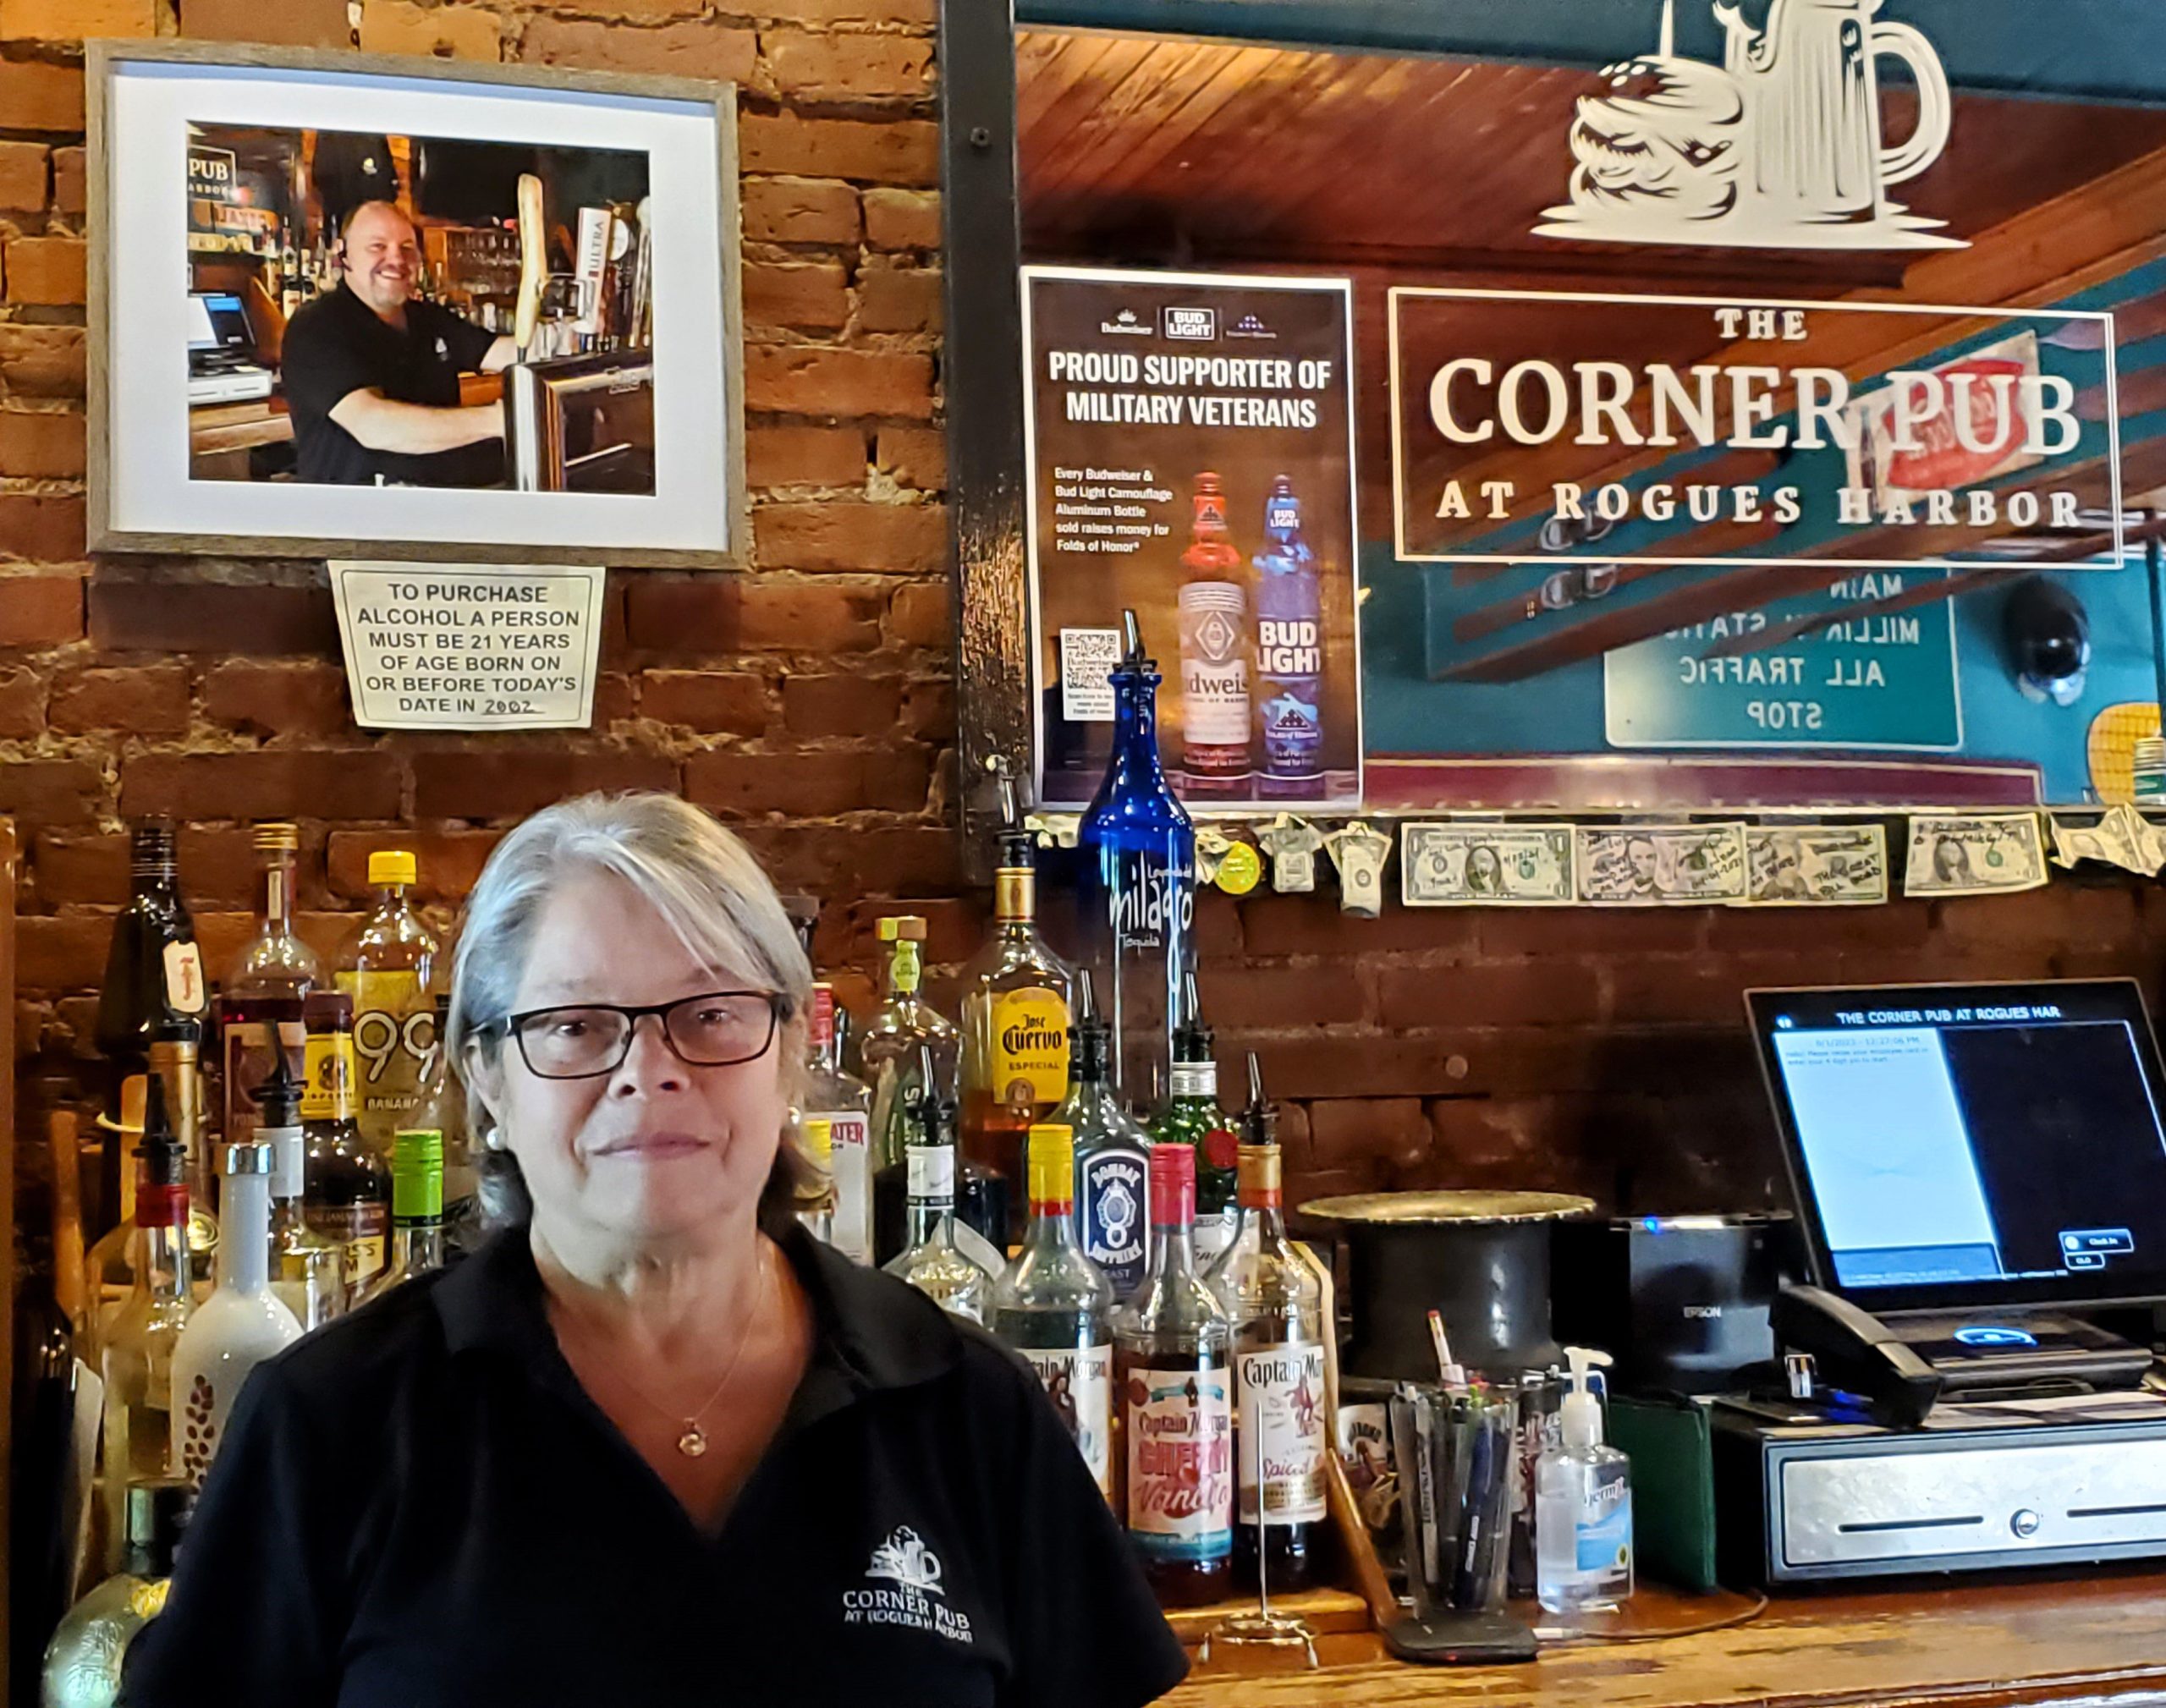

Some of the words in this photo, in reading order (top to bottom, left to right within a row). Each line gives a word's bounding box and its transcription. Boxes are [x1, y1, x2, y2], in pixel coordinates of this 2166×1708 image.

[189, 158, 228, 180] PUB
[590, 220, 606, 269] ULTRA
[1174, 311, 1206, 323] BUD
[1715, 309, 1808, 339] THE
[1168, 323, 1211, 336] LIGHT
[1048, 351, 1139, 383] PROUD
[1144, 355, 1292, 388] SUPPORTER
[1298, 360, 1332, 389] OF
[1066, 392, 1183, 423] MILITARY
[1188, 396, 1317, 427] VETERANS
[1429, 359, 1853, 448] CORNER
[1885, 371, 2080, 455] PUB
[1054, 467, 1084, 482] Every
[1086, 468, 1141, 481] Budweiser
[1143, 470, 1153, 481] &
[1054, 485, 1077, 497] Bud
[1079, 486, 1106, 500] Light
[1108, 486, 1173, 502] Camouflage
[1055, 503, 1111, 516] Aluminum
[1113, 505, 1146, 517] Bottle
[1436, 481, 1514, 519] AT
[1553, 482, 1801, 522] ROGUES
[1838, 490, 2082, 528] HARBOR
[1273, 509, 1296, 518] BUD
[1055, 521, 1079, 533] sold
[1081, 523, 1113, 534] raises
[1116, 525, 1152, 537] money
[1154, 524, 1170, 535] for
[1270, 519, 1300, 528] LIGHT
[1057, 539, 1086, 551] Folds
[1087, 540, 1099, 552] of
[388, 584, 419, 600] TO
[426, 585, 548, 602] PURCHASE
[357, 608, 465, 626] ALCOHOL
[470, 611, 485, 626] A
[492, 611, 579, 627] PERSON
[369, 633, 428, 648] MUST
[436, 634, 465, 649] BE
[470, 634, 492, 649] 21
[499, 634, 570, 649] YEARS
[1259, 621, 1317, 646] BUD
[381, 656, 409, 670] OF
[415, 656, 459, 670] AGE
[465, 656, 524, 671] BORN
[531, 656, 560, 670] ON
[366, 677, 396, 690] OR
[404, 678, 485, 692] BEFORE
[492, 677, 576, 691] TODAY'S
[399, 698, 451, 712] DATE
[457, 699, 475, 712] IN
[1836, 1013, 1864, 1024] THE
[1868, 1011, 1921, 1024] CORNER
[1926, 1010, 1952, 1022] PUB
[1956, 1009, 1972, 1020] AT
[1976, 1007, 2030, 1019] ROGUES
[2031, 1006, 2061, 1018] HAR
[353, 1009, 435, 1083] 99
[1002, 1024, 1062, 1056] Cuervo
[1009, 1062, 1059, 1071] ESPECIAL
[1684, 1306, 1721, 1318] EPSON
[1244, 1357, 1302, 1388] Captain
[1139, 1412, 1187, 1437] Captain
[843, 1590, 929, 1616] CORNER
[934, 1602, 970, 1629] PUB
[844, 1610, 864, 1623] AT
